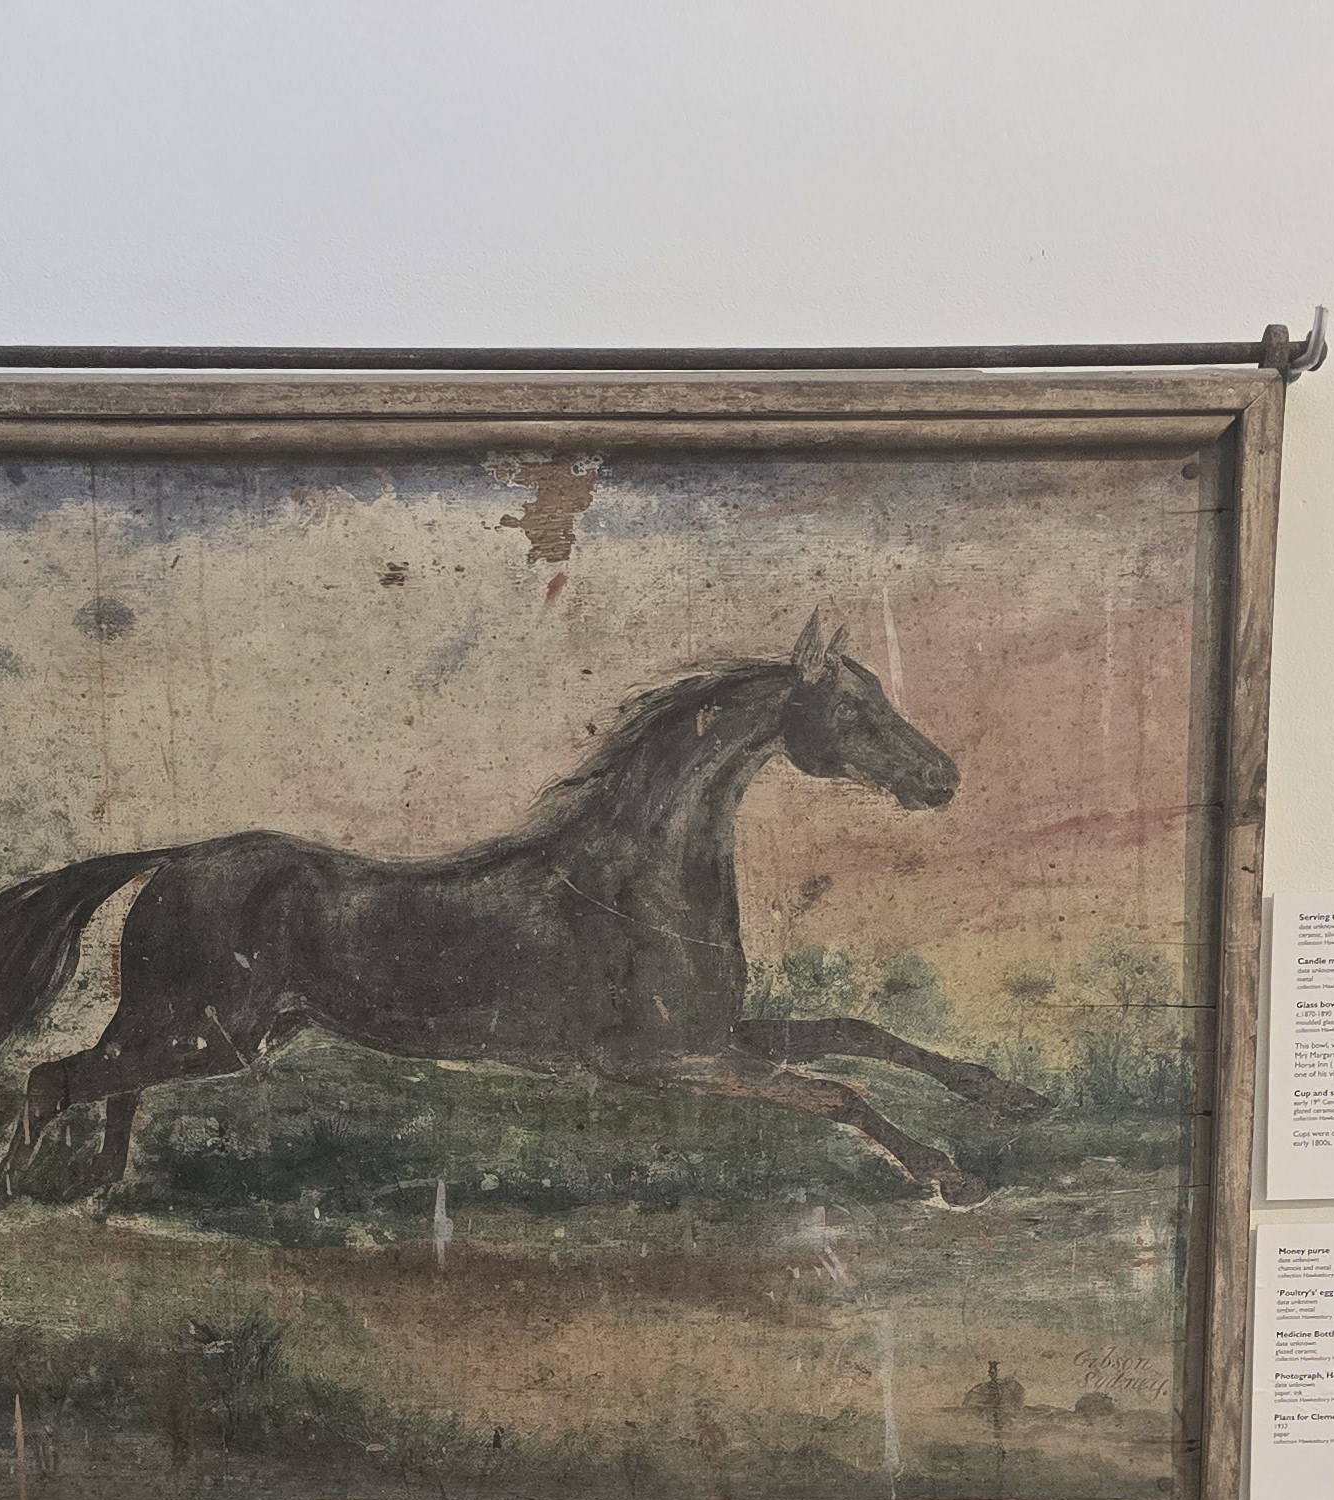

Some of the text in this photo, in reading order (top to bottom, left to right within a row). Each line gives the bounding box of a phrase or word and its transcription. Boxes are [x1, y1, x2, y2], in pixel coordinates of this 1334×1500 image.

[1299, 913, 1330, 923] Serving
[1294, 1089, 1311, 1099] Cup
[1278, 1247, 1330, 1256] Money purse
[1319, 1290, 1333, 1298] egg
[1276, 1330, 1312, 1338] Medicine
[1274, 1413, 1295, 1421] Plans
[1297, 1413, 1308, 1421] for
